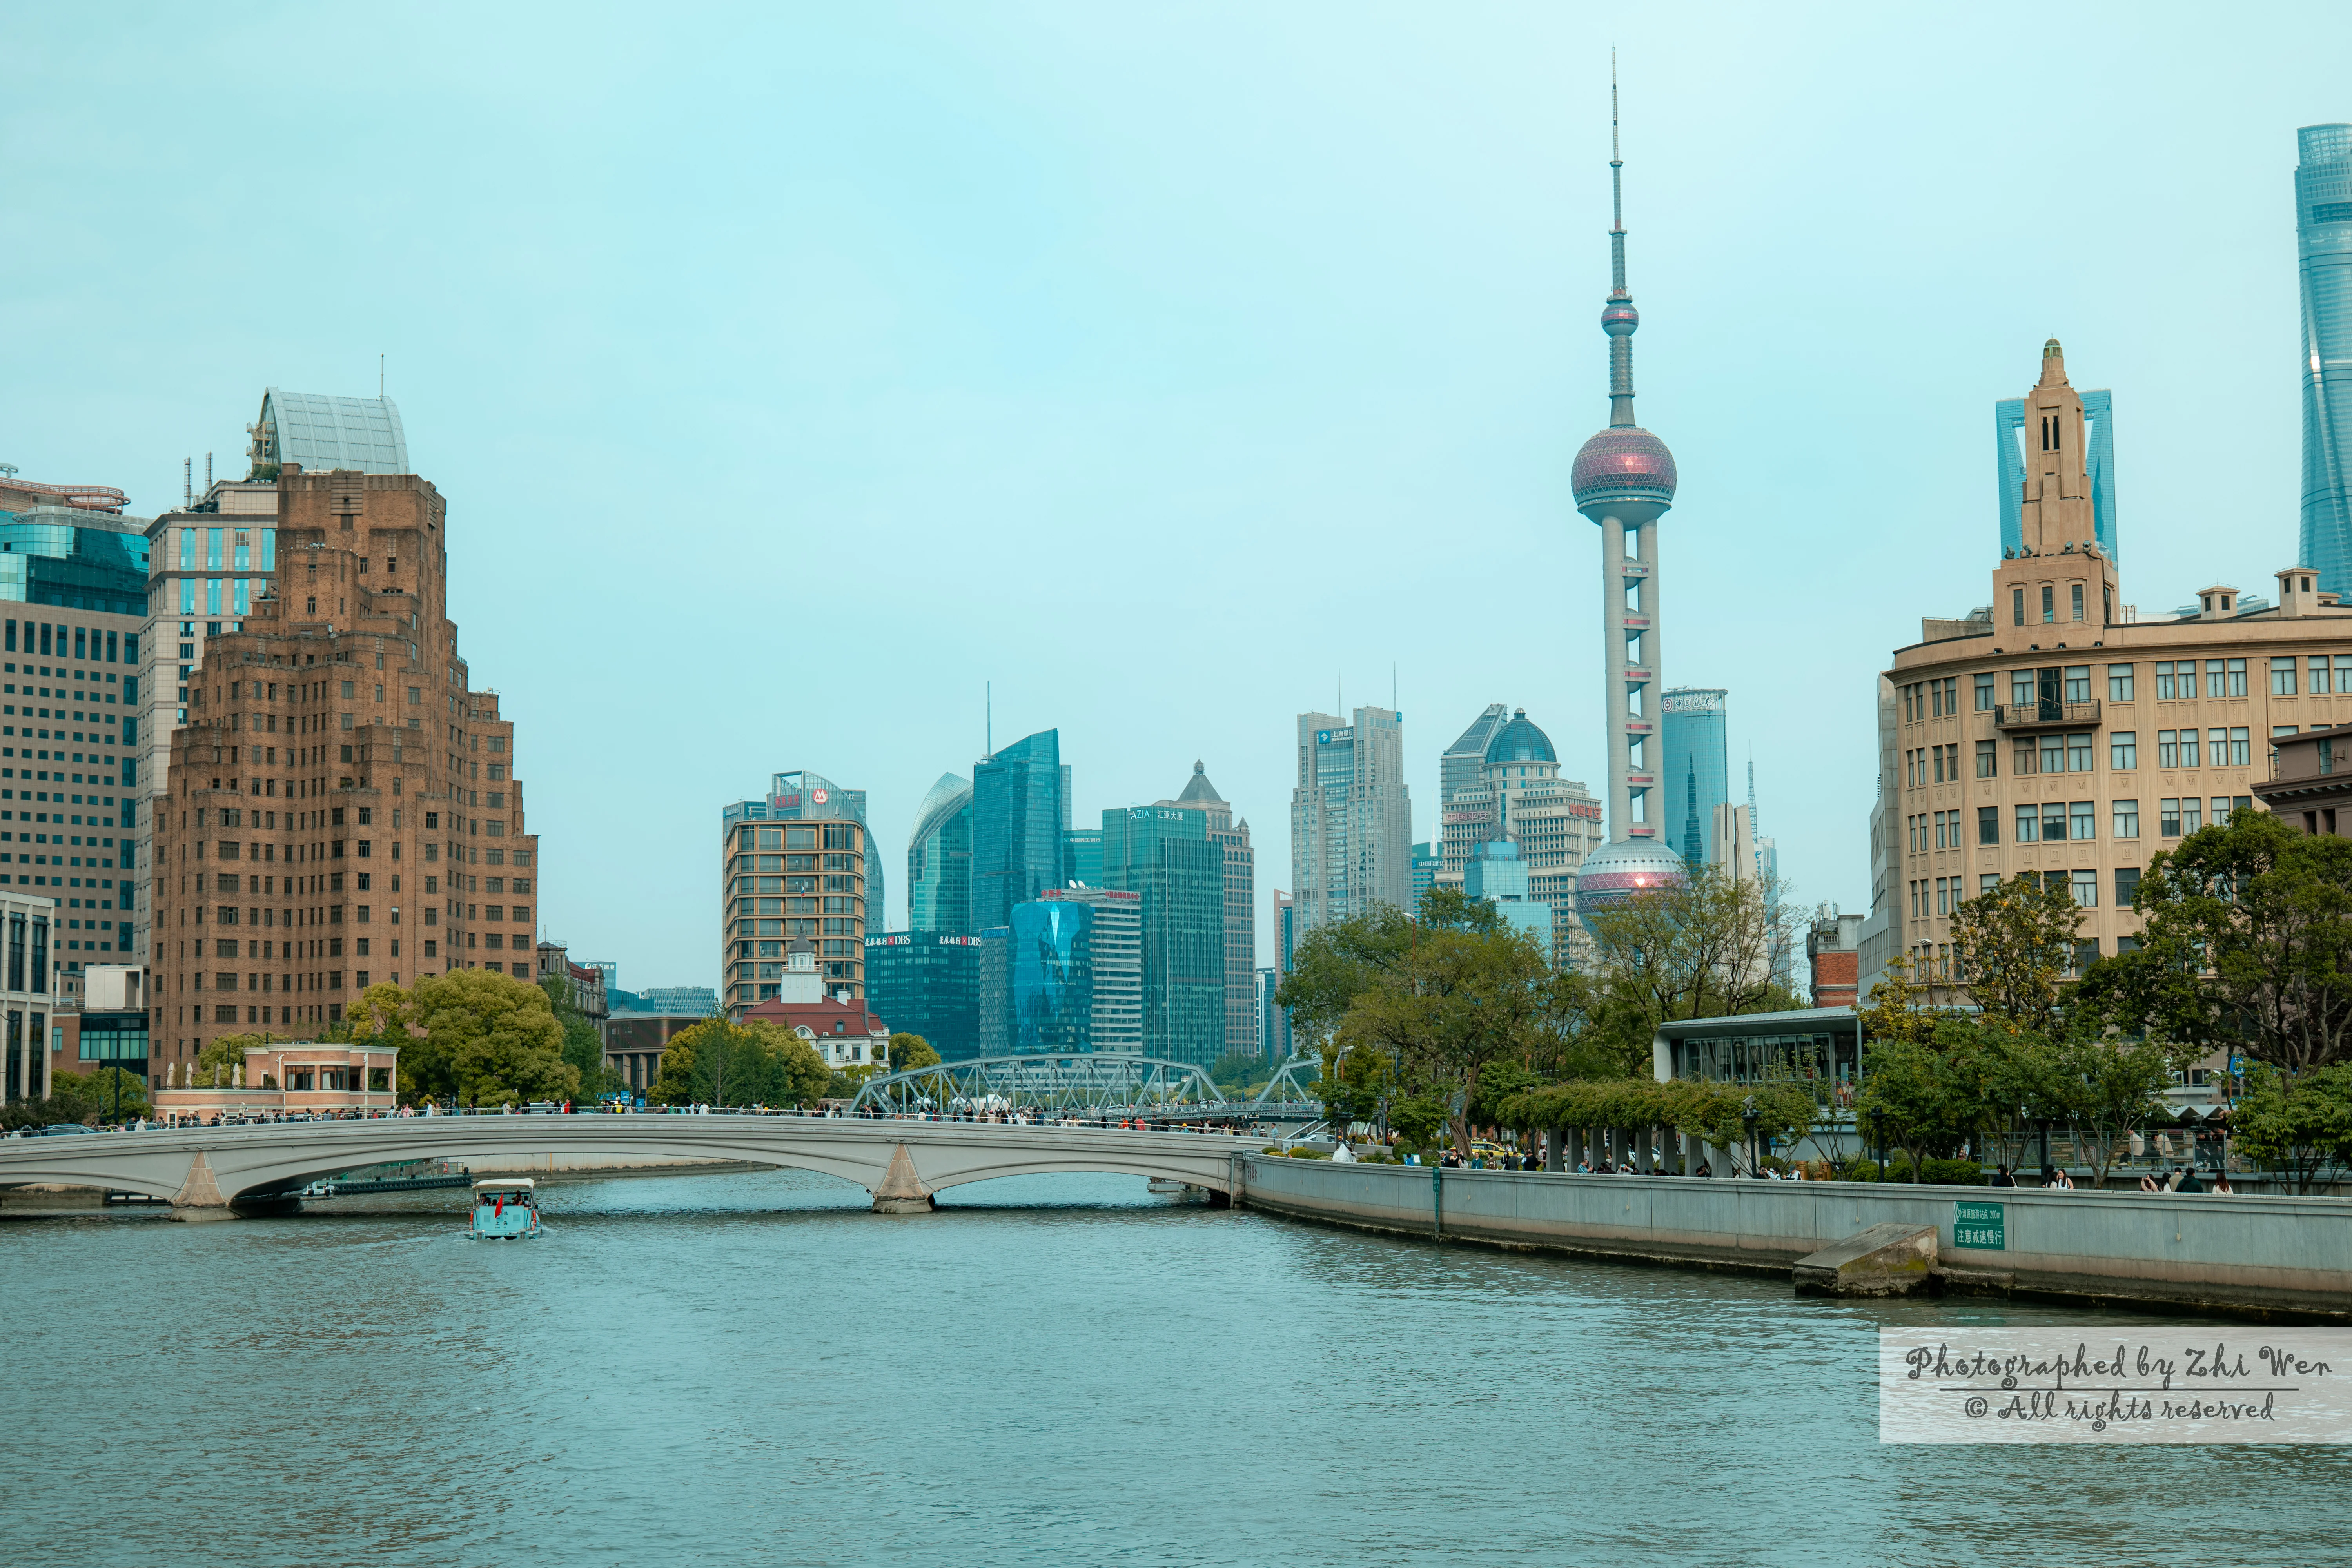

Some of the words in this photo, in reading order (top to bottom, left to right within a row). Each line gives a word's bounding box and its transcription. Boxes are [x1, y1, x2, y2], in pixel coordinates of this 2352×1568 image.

[1131, 809, 1150, 819] AZIA
[1157, 810, 1183, 820] 汇亚大厦
[1447, 811, 1488, 822] 中国平安
[1570, 803, 1602, 819] 中国平安
[895, 935, 911, 945] DBS
[1958, 1208, 1988, 1220] 外滩源旅游站点
[1990, 1210, 2000, 1219] 200m
[1957, 1229, 2002, 1245] 注意减速慢行
